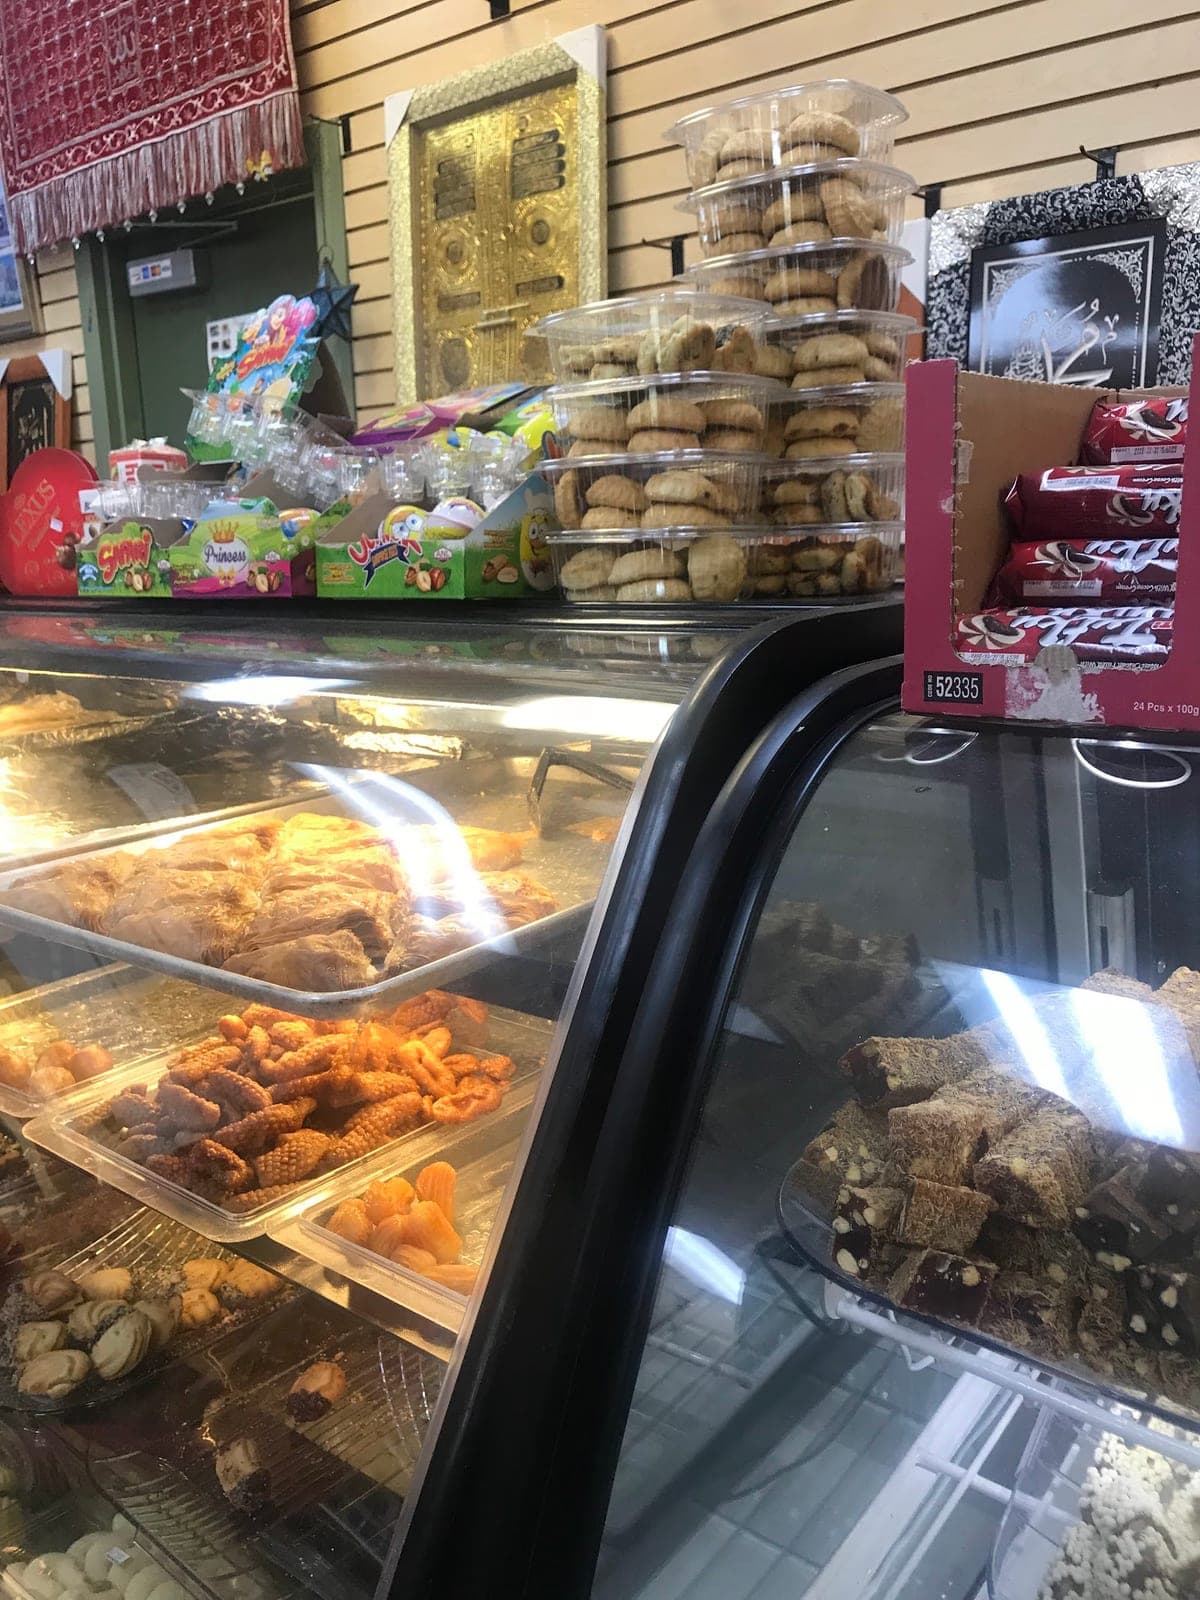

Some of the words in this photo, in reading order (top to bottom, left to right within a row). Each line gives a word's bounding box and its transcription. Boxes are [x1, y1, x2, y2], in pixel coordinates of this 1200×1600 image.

[8, 478, 57, 548] LEXUS
[204, 544, 247, 563] Princess
[936, 676, 979, 699] 52335
[1133, 701, 1145, 711] 24
[1147, 702, 1165, 712] Pcs
[1177, 704, 1199, 716] 100g
